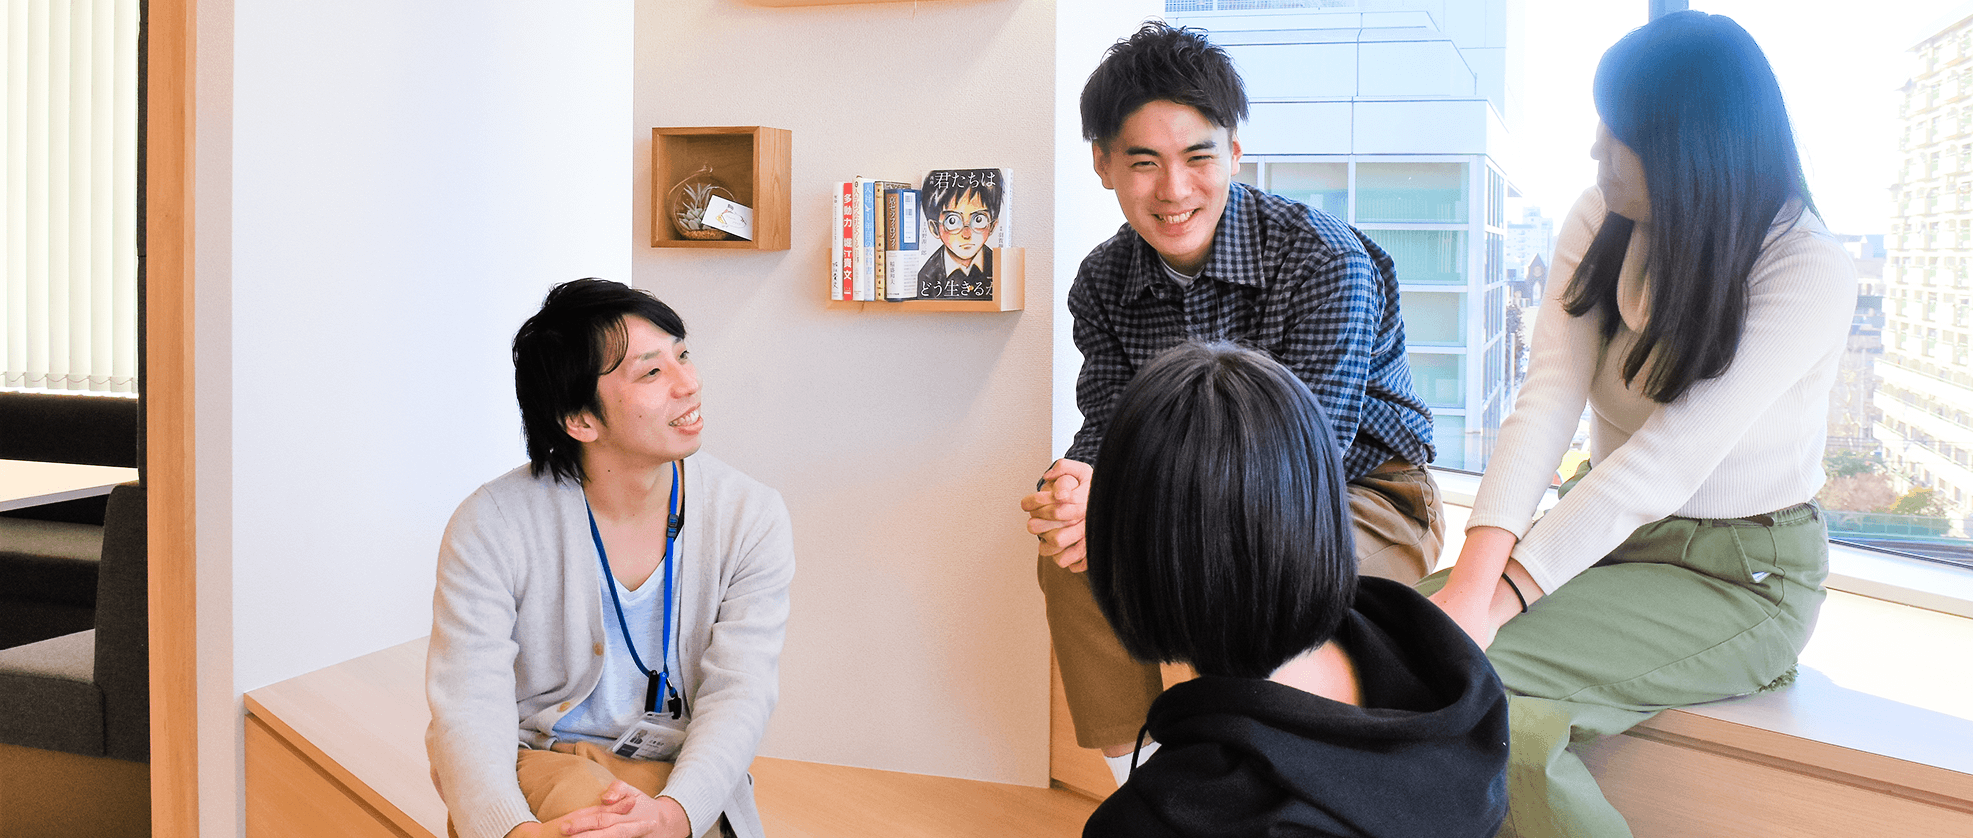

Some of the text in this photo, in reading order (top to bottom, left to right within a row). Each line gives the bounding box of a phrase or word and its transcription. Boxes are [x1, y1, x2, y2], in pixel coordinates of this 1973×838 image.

[934, 171, 996, 190] 君たちは
[844, 193, 852, 228] 多動力
[844, 238, 852, 280] 堀江貴文
